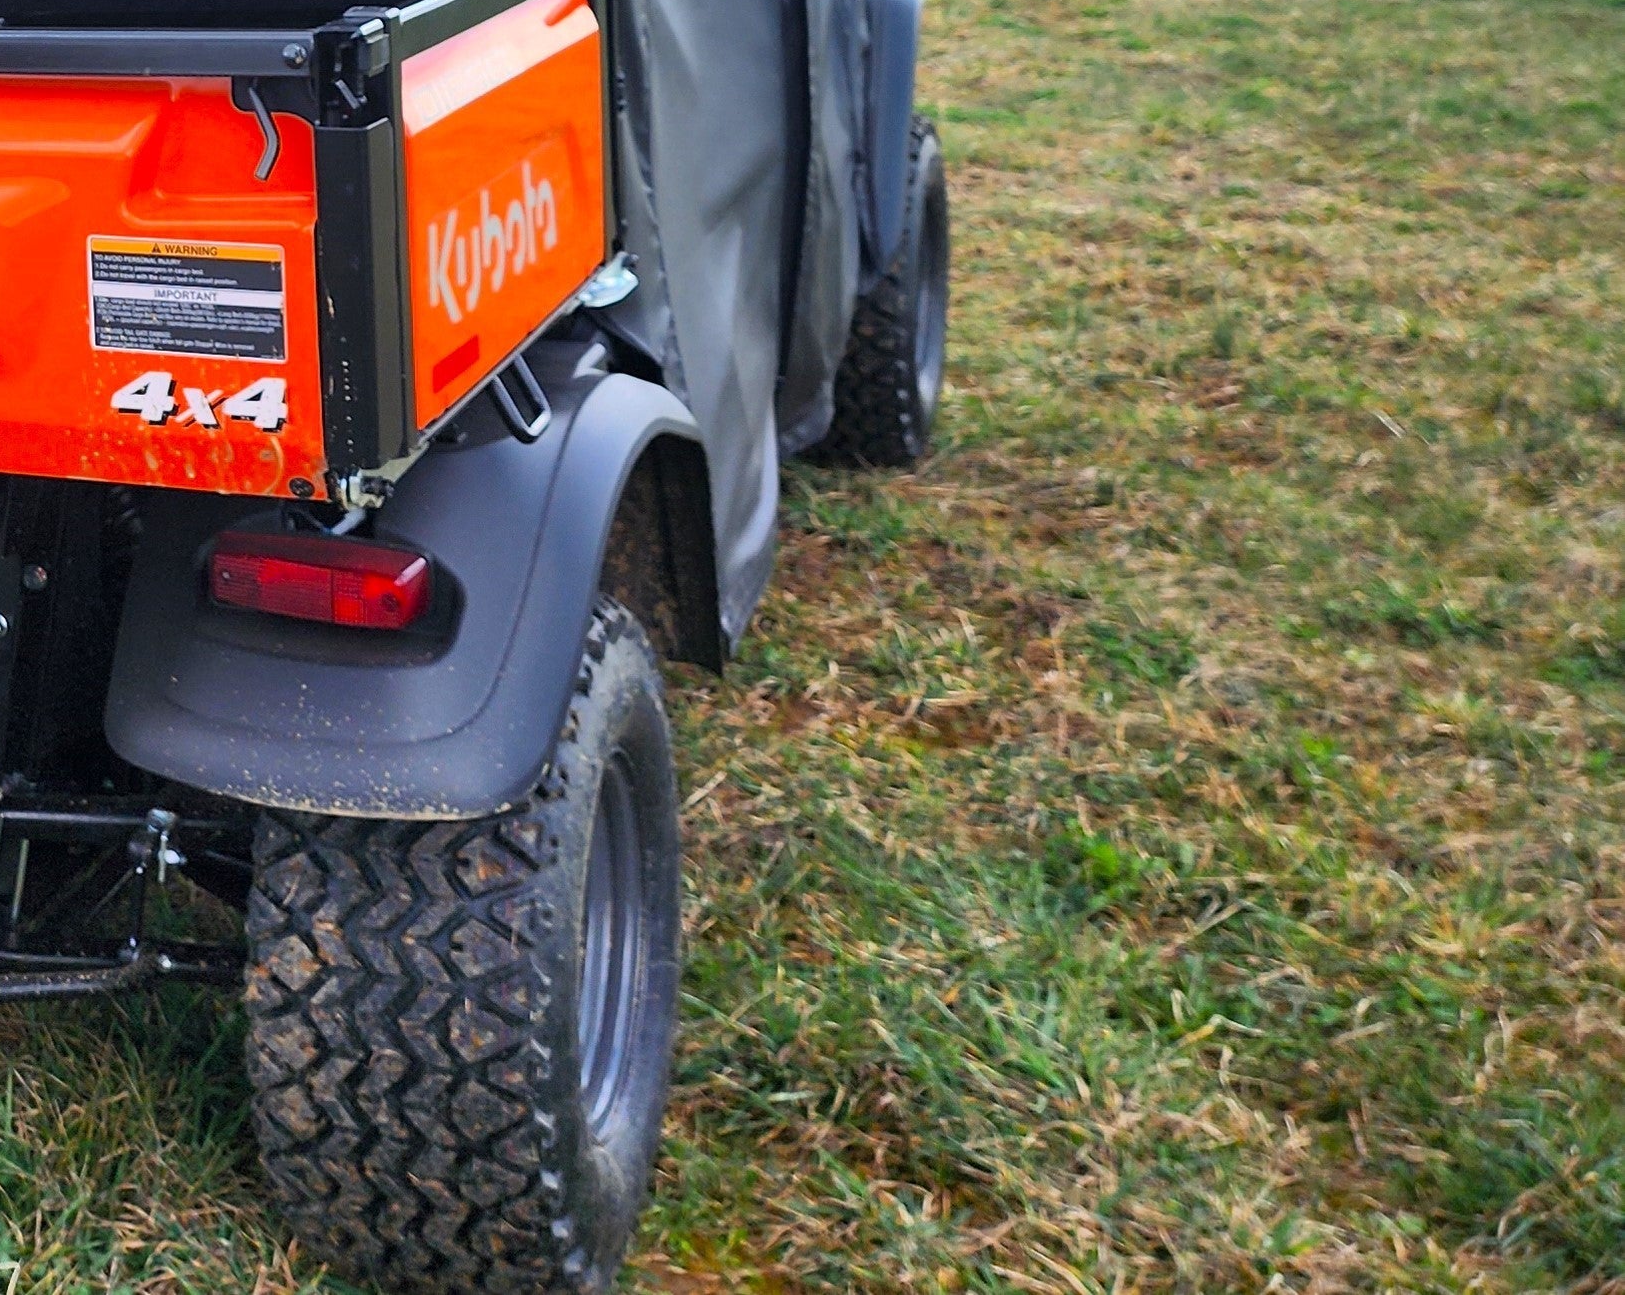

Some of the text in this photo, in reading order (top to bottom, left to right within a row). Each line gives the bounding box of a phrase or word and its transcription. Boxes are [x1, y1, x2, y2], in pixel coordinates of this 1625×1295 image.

[164, 244, 218, 256] WARNING
[427, 159, 558, 325] Kubota
[154, 288, 217, 302] IMPORTANT
[110, 371, 289, 433] 4x4
